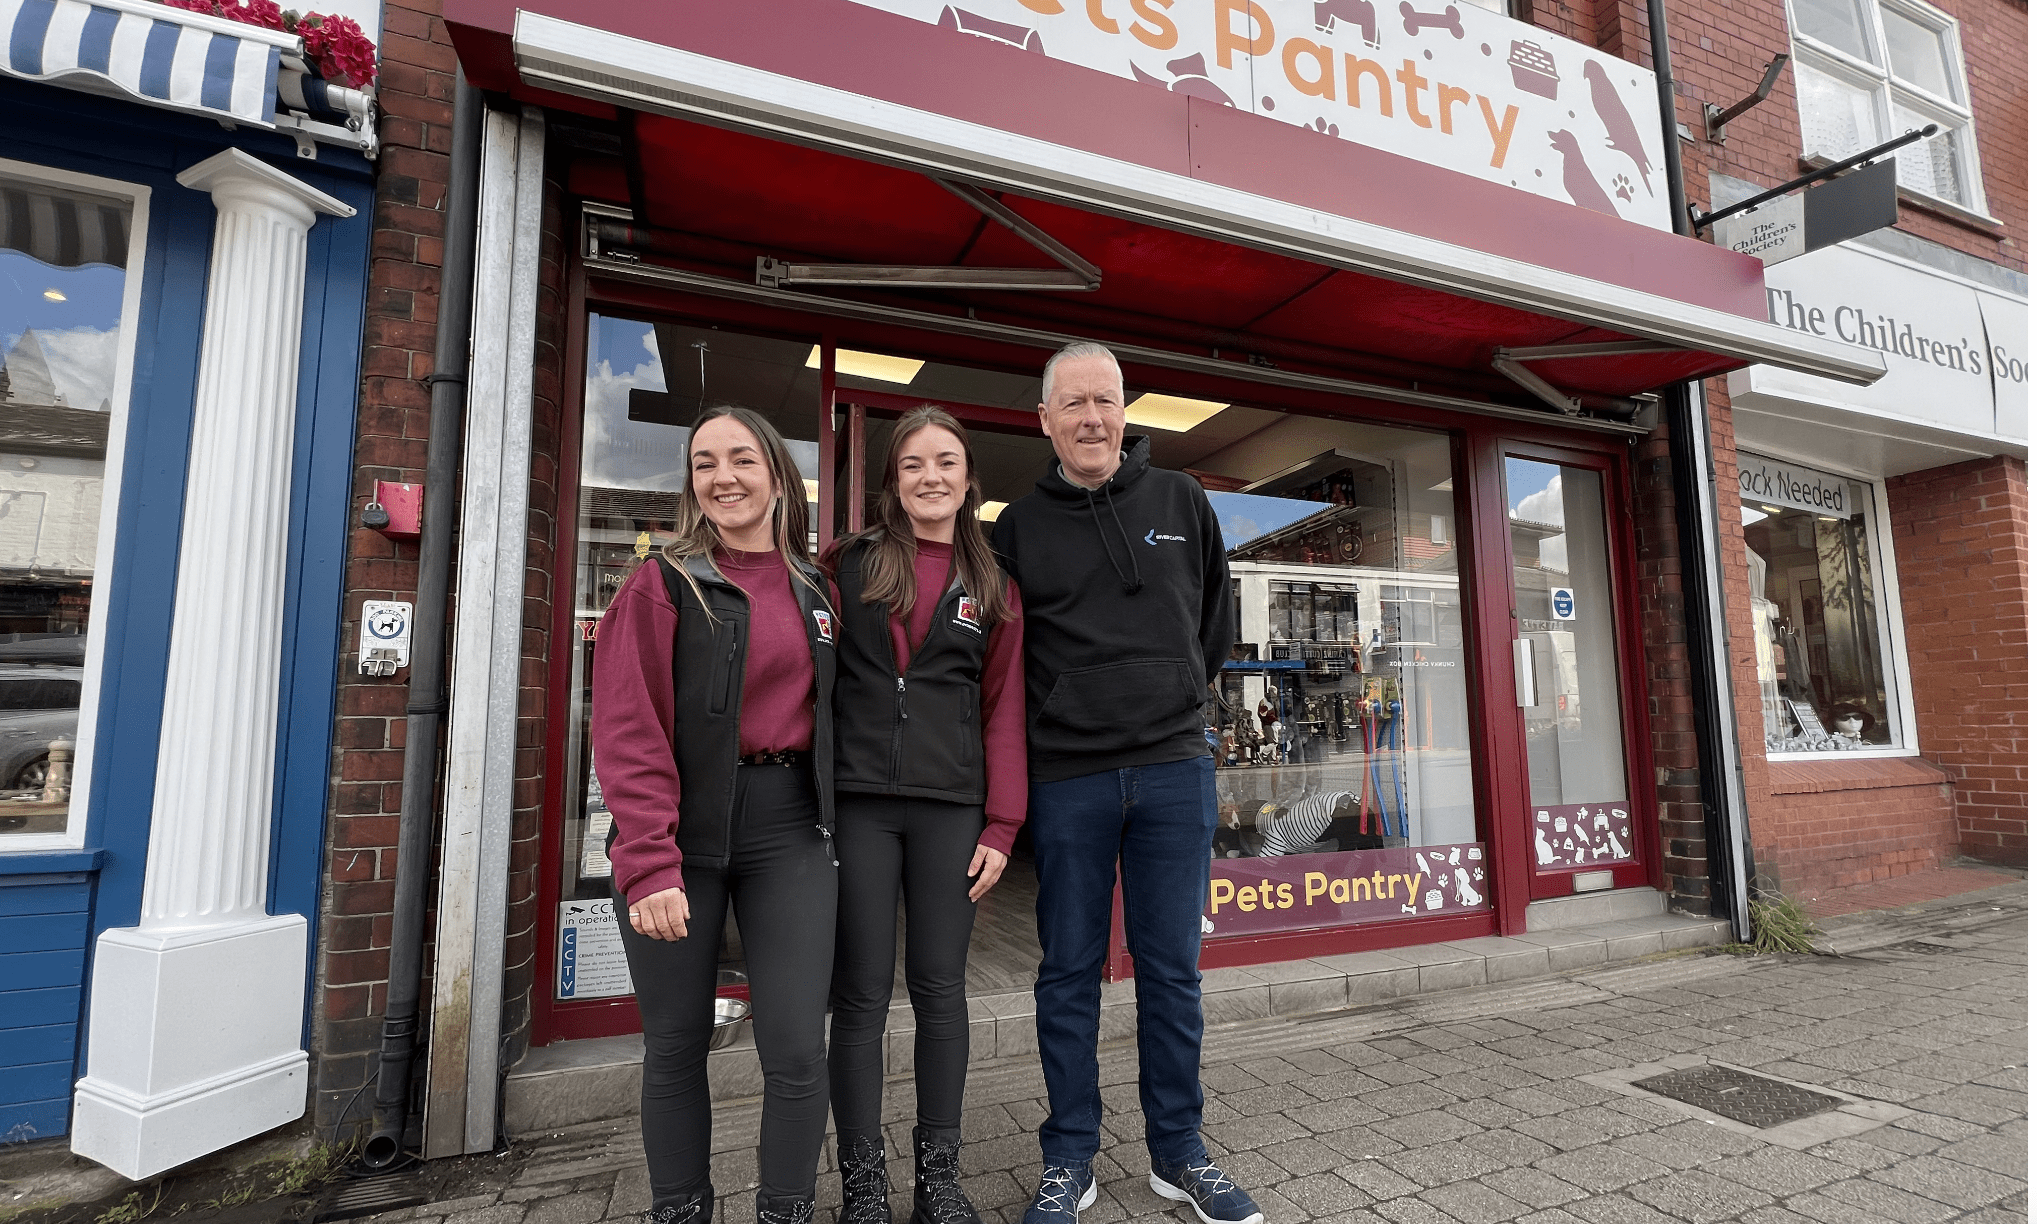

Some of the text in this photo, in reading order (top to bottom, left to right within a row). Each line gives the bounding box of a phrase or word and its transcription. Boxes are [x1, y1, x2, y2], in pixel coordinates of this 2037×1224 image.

[1214, 0, 1520, 170] Pantry
[1732, 223, 1797, 251] Children's
[1751, 222, 1775, 235] The
[1766, 286, 2028, 384] The Children's So
[1739, 465, 1843, 512] ock Needed
[590, 903, 615, 915] CCT
[1210, 869, 1422, 915] Pets Pantry
[565, 914, 618, 926] in operatio
[562, 933, 575, 991] CCTV
